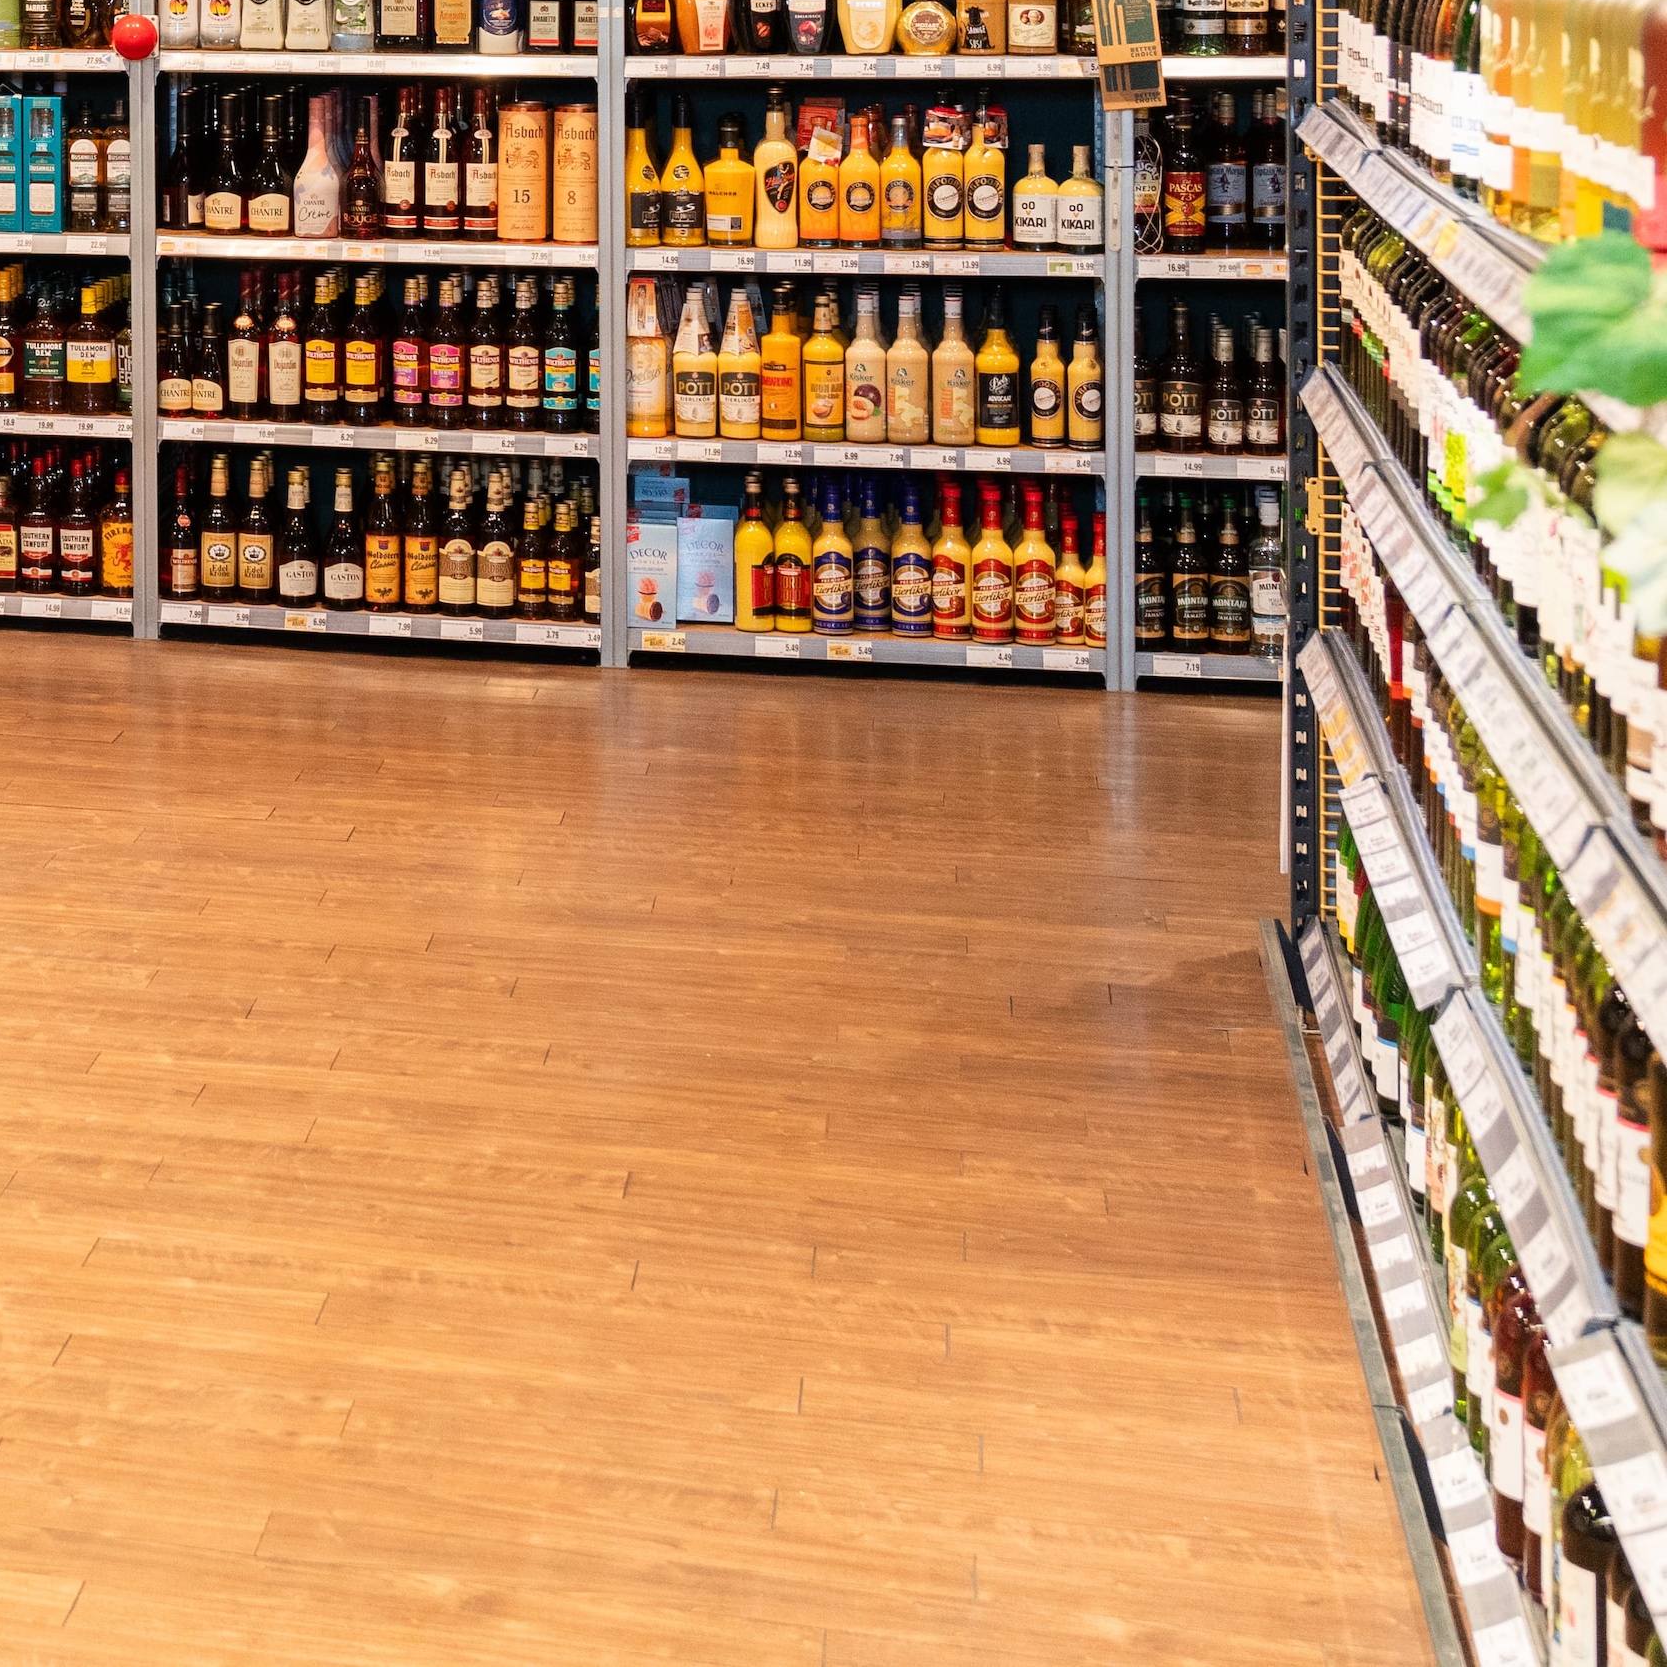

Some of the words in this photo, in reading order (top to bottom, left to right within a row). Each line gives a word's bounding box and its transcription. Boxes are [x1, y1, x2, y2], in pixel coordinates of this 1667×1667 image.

[505, 122, 544, 138] Asbach
[1170, 184, 1202, 192] PASCAS
[515, 190, 530, 204] 15
[568, 191, 576, 204] 8
[1014, 216, 1046, 227] KIKARI
[661, 256, 678, 264] 14.99
[841, 259, 858, 268] 13.99
[1167, 264, 1185, 272] 16.99
[70, 344, 110, 353] TULLAMORE
[679, 382, 711, 395] POTT
[630, 549, 668, 558] DECOR
[816, 581, 850, 597] Eierlikör
[398, 623, 410, 631] 7.99
[671, 638, 684, 646] 2.49
[1186, 663, 1199, 672] 7.19
